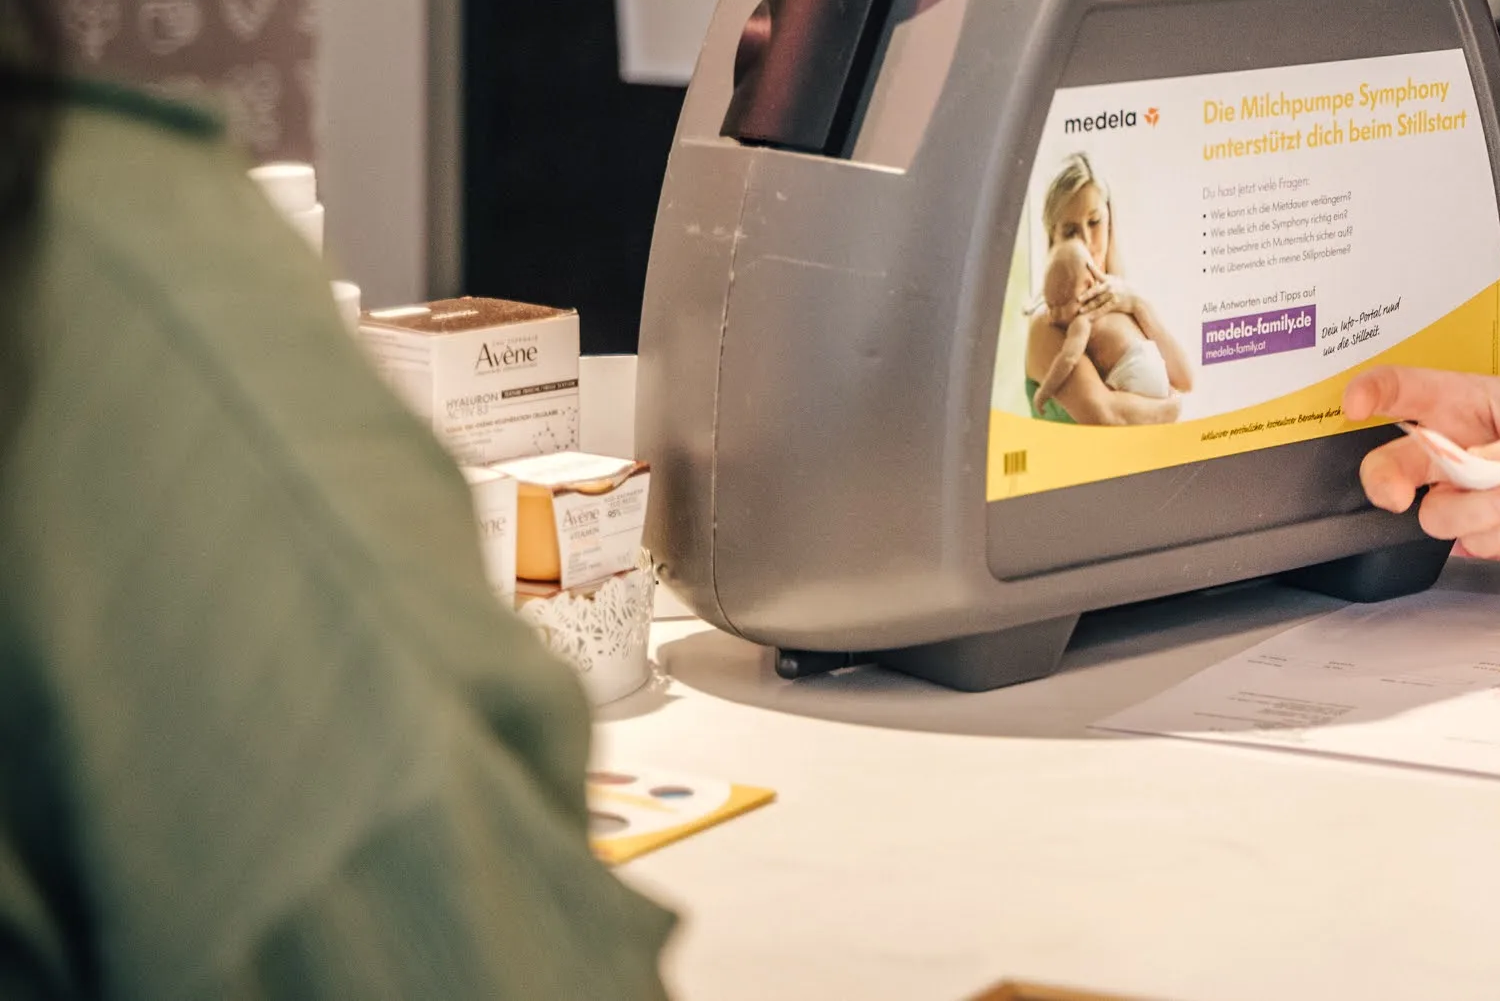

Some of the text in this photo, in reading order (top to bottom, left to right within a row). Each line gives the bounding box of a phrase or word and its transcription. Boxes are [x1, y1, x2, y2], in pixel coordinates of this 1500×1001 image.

[1203, 76, 1450, 125] Die Milchpumpe Symphony
[1065, 109, 1137, 134] medela
[1203, 110, 1468, 161] unterstützt dich beim Stillstart
[1217, 185, 1236, 198] hast
[1201, 286, 1316, 314] Alle Antworten und Tipps auf
[1205, 310, 1312, 344] medela-family.de
[1321, 325, 1338, 339] Dein
[475, 343, 538, 369] Avène
[1205, 340, 1266, 360] medela-family.at
[446, 393, 499, 409] HYALURON
